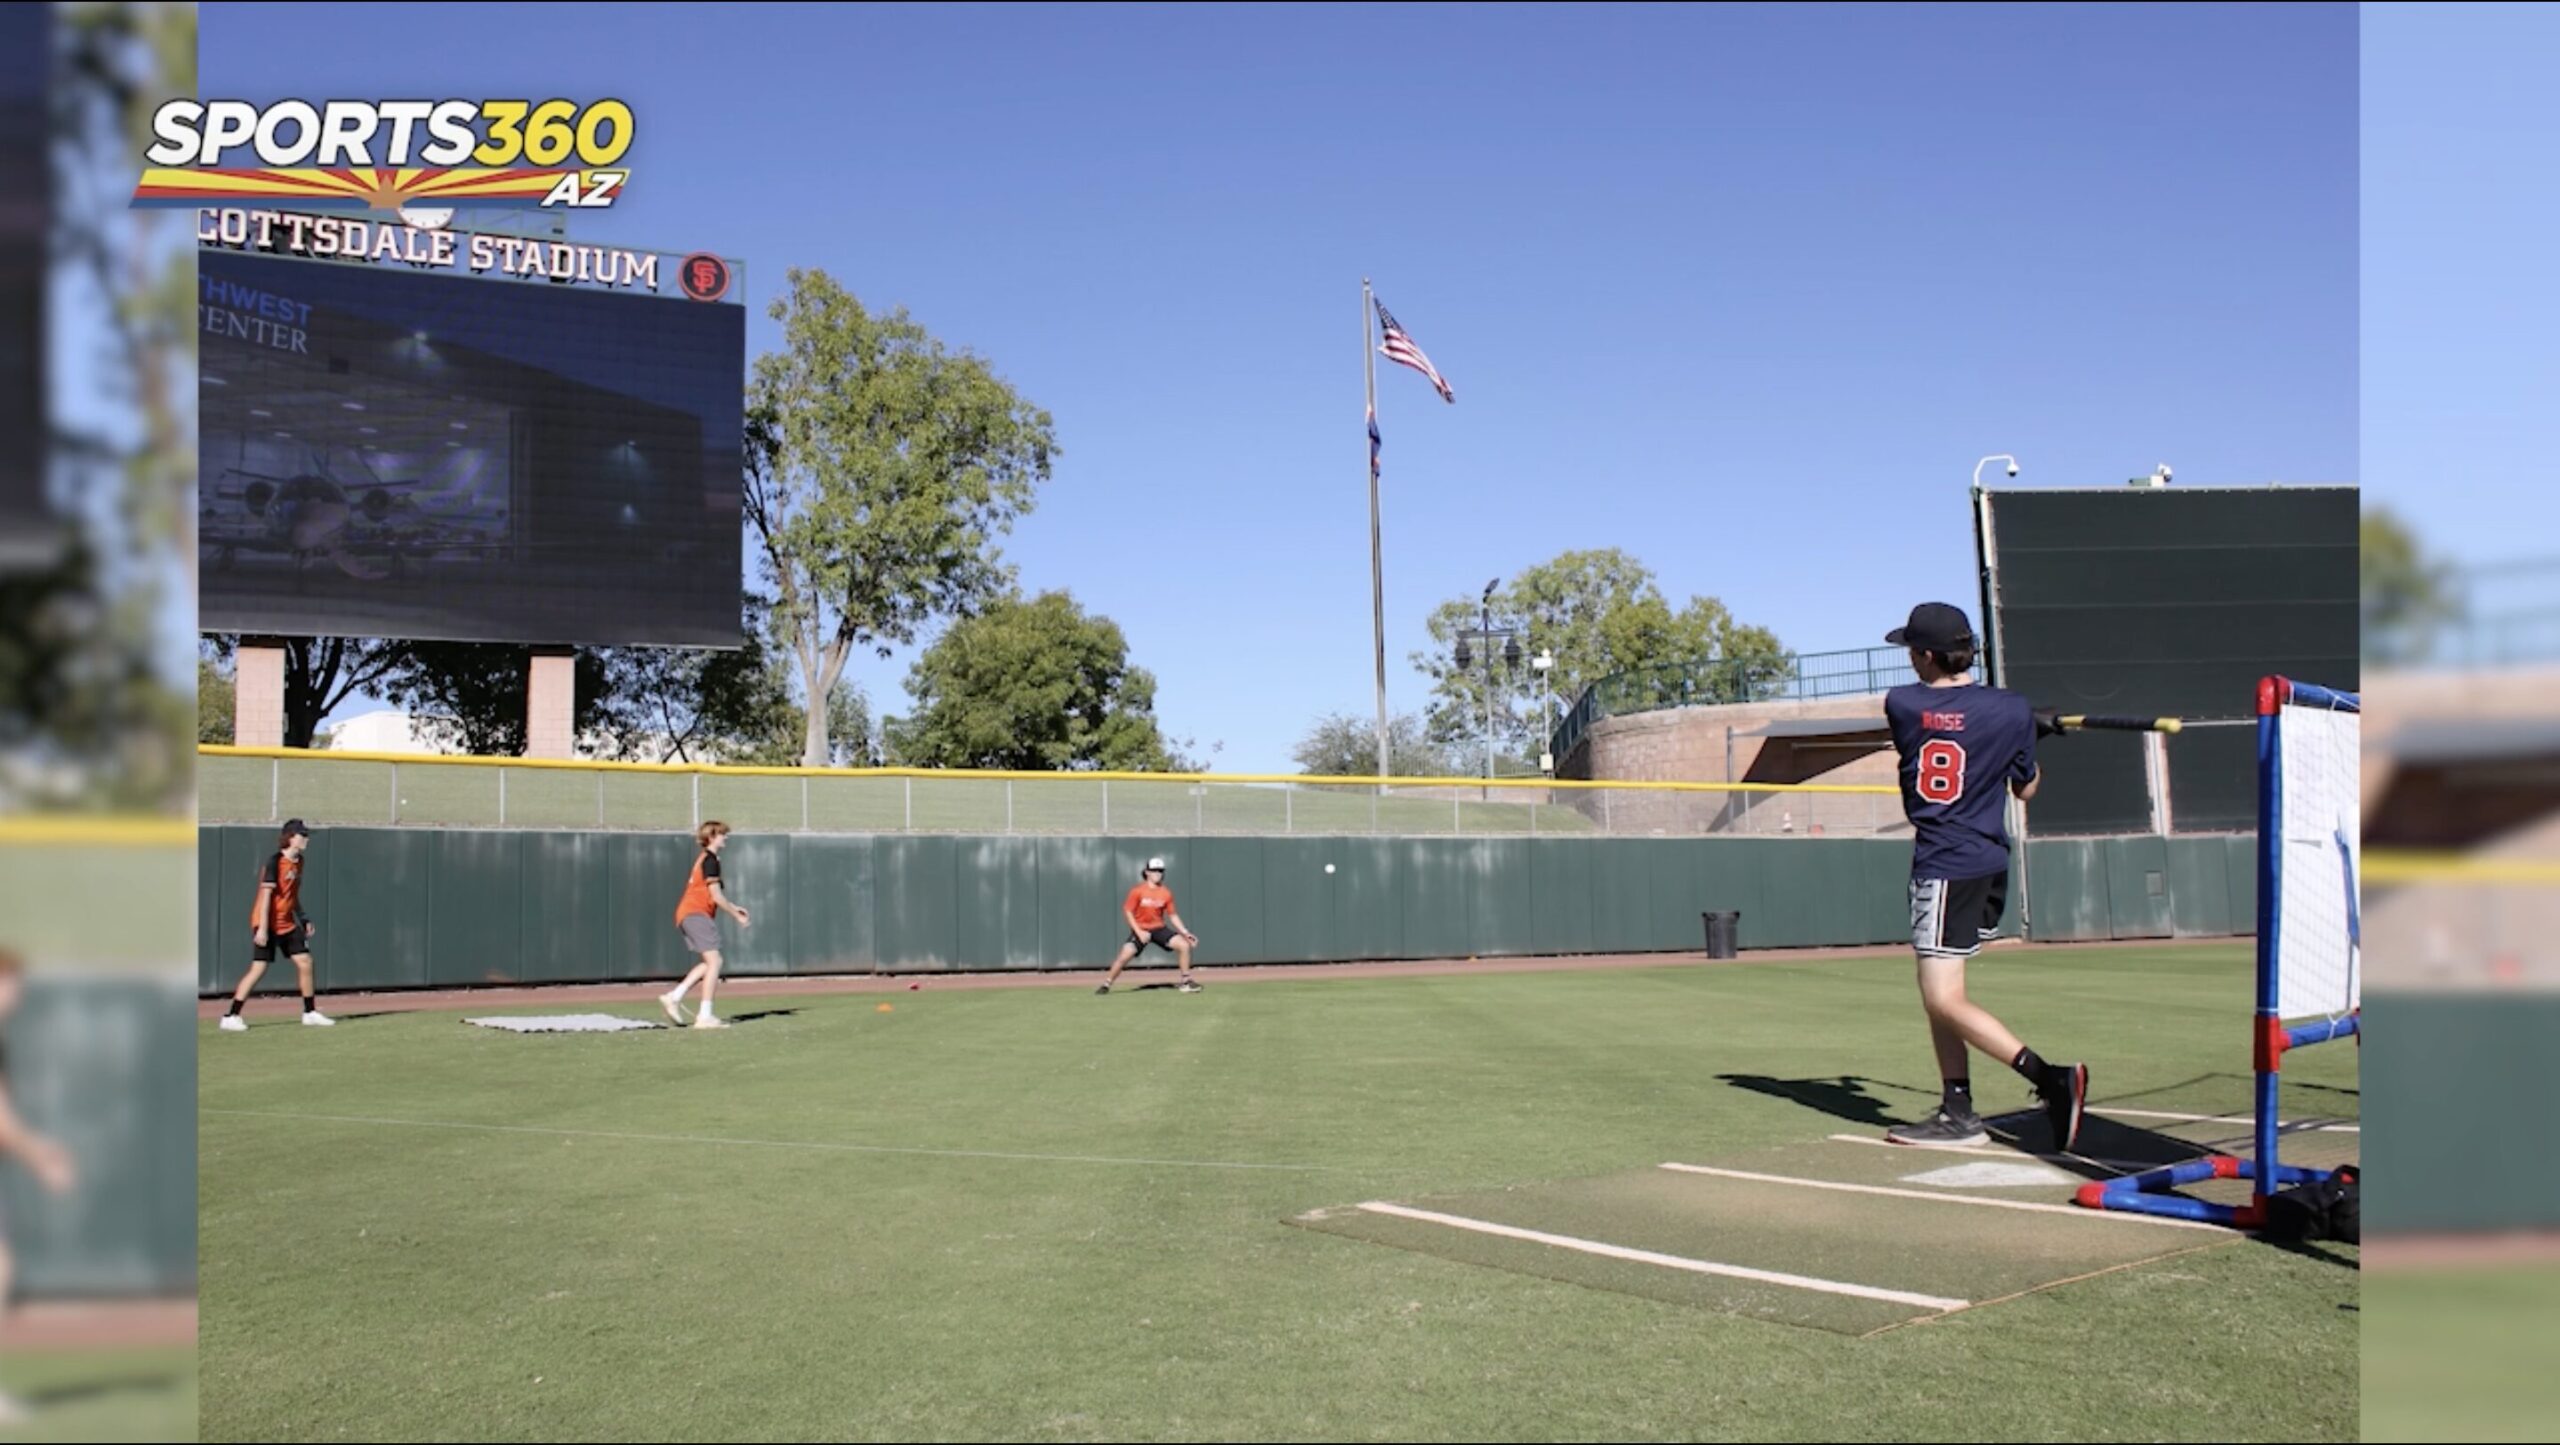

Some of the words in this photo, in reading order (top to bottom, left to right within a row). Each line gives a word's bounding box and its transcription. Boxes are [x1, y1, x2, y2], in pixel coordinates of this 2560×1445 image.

[198, 207, 455, 265] COTTSDALE
[471, 234, 657, 287] STADIUM
[199, 304, 309, 354] ENTER
[1921, 711, 1966, 731] ROSE
[1916, 738, 1966, 805] 8
